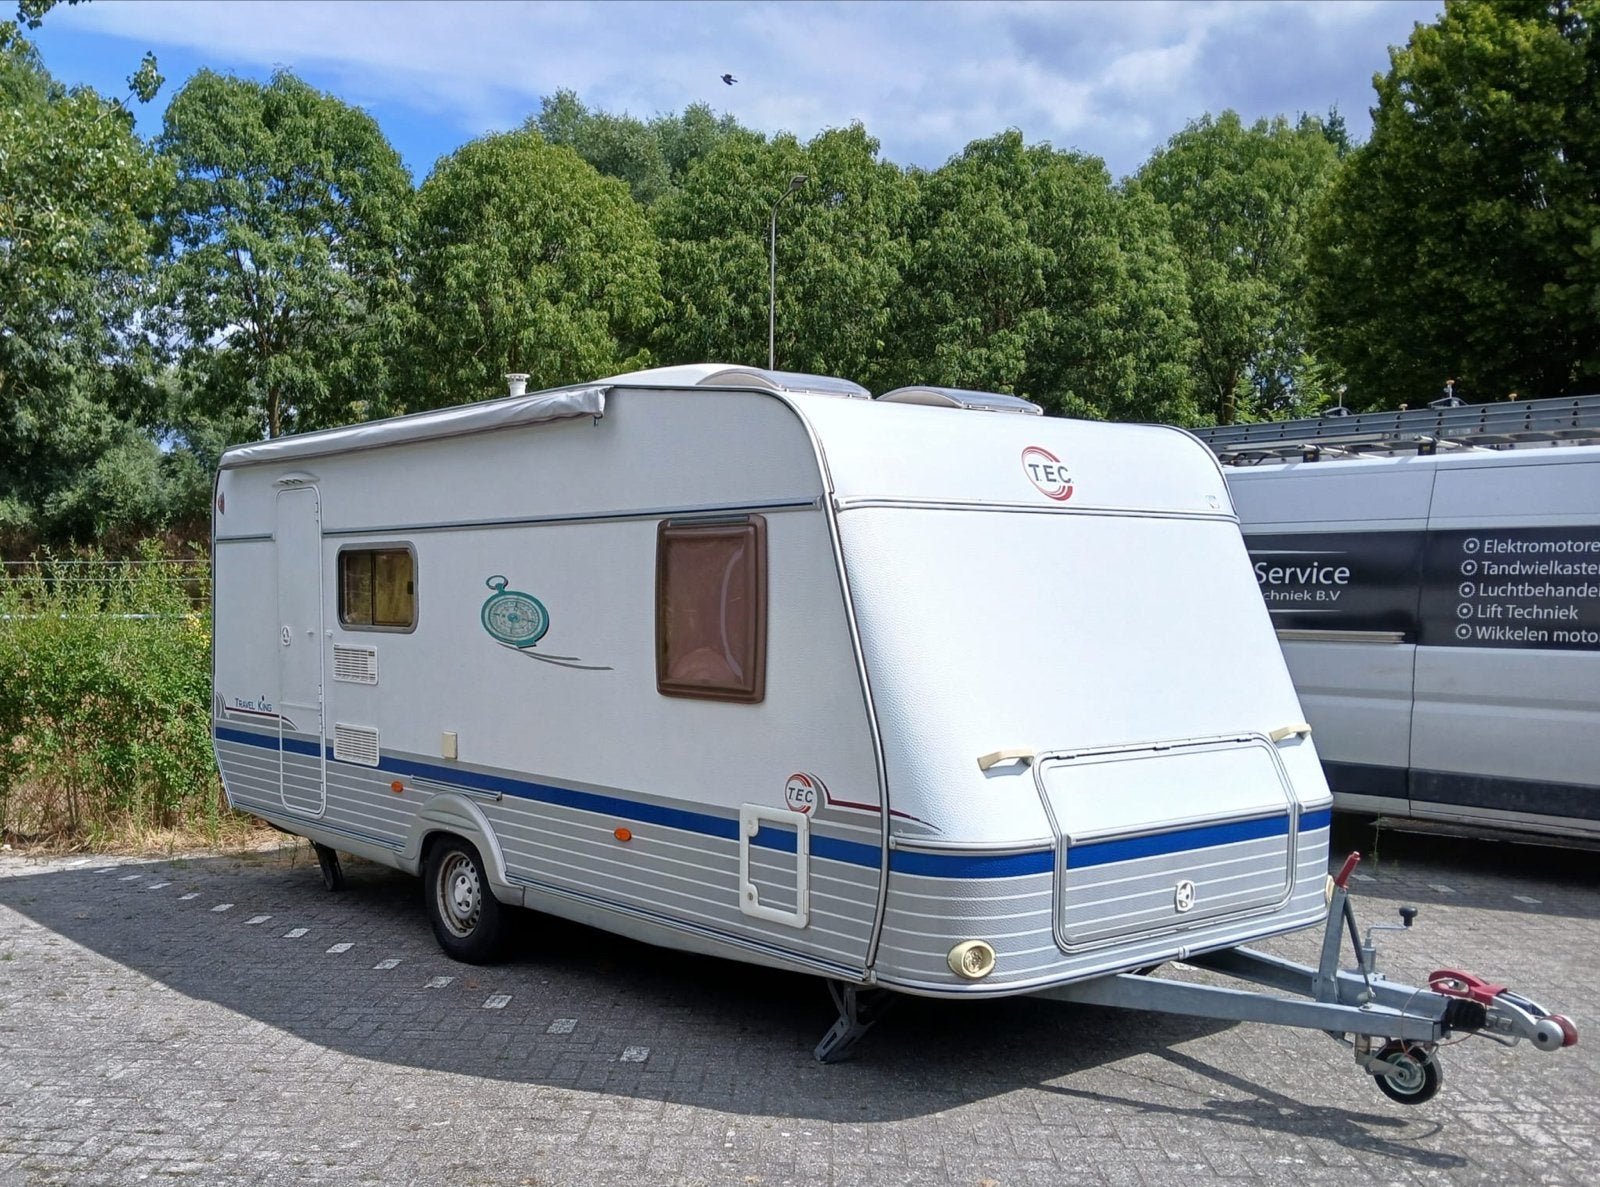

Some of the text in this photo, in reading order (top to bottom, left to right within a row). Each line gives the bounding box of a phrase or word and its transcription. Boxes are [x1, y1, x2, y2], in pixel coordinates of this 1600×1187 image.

[1254, 561, 1350, 585] Service
[1481, 560, 1600, 575] Tandwielkaste
[1479, 582, 1600, 597] Luchtbehande
[1477, 604, 1579, 620] Lift Techniek
[1476, 625, 1600, 643] Wikkelen moto
